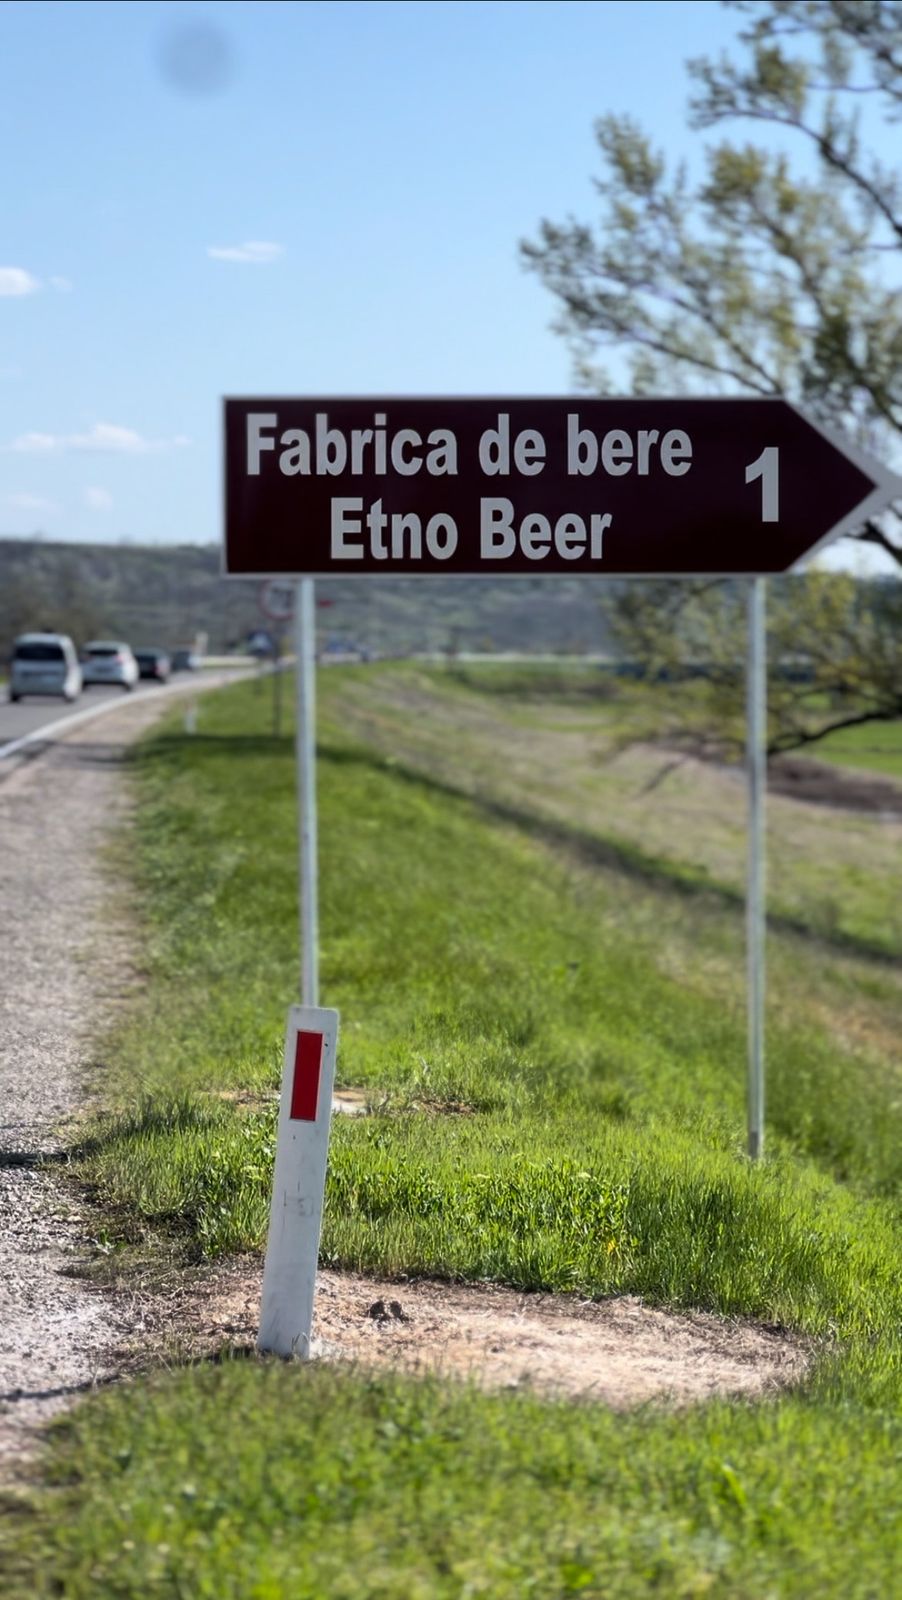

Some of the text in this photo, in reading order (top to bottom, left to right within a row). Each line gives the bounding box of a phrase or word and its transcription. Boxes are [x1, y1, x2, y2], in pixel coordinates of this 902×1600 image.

[246, 413, 693, 476] Fabrica de bere
[745, 447, 779, 522] 1
[331, 497, 613, 560] Etno Beer
